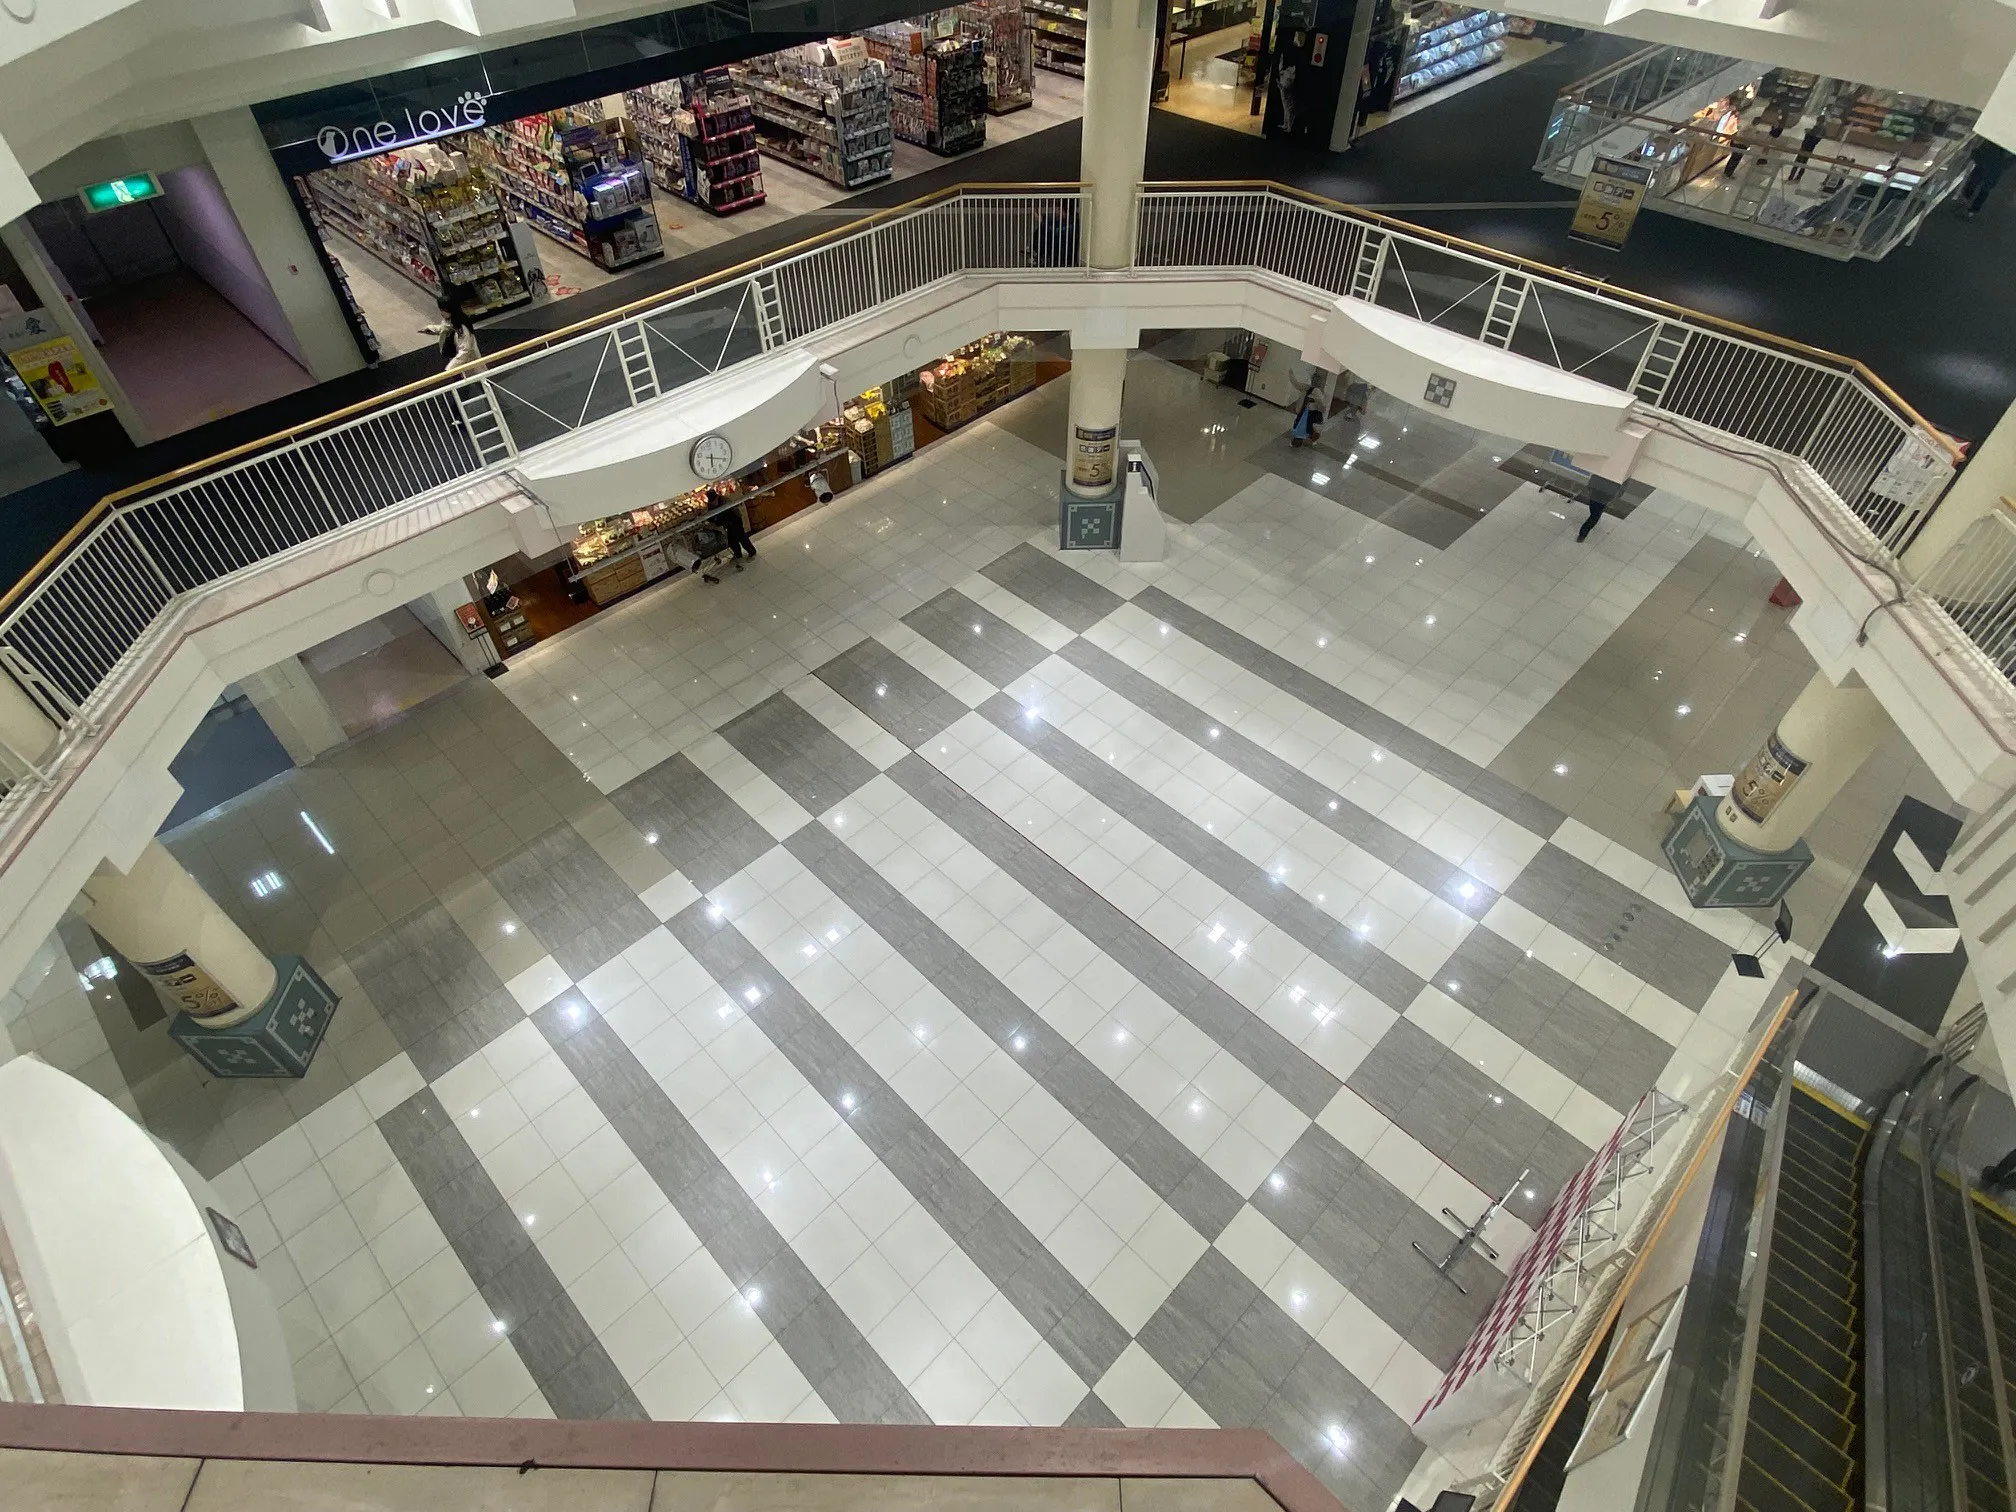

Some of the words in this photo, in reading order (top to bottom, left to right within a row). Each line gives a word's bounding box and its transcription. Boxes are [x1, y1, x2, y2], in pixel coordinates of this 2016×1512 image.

[317, 121, 396, 158] One
[404, 97, 486, 139] love
[182, 989, 218, 1009] 5%
